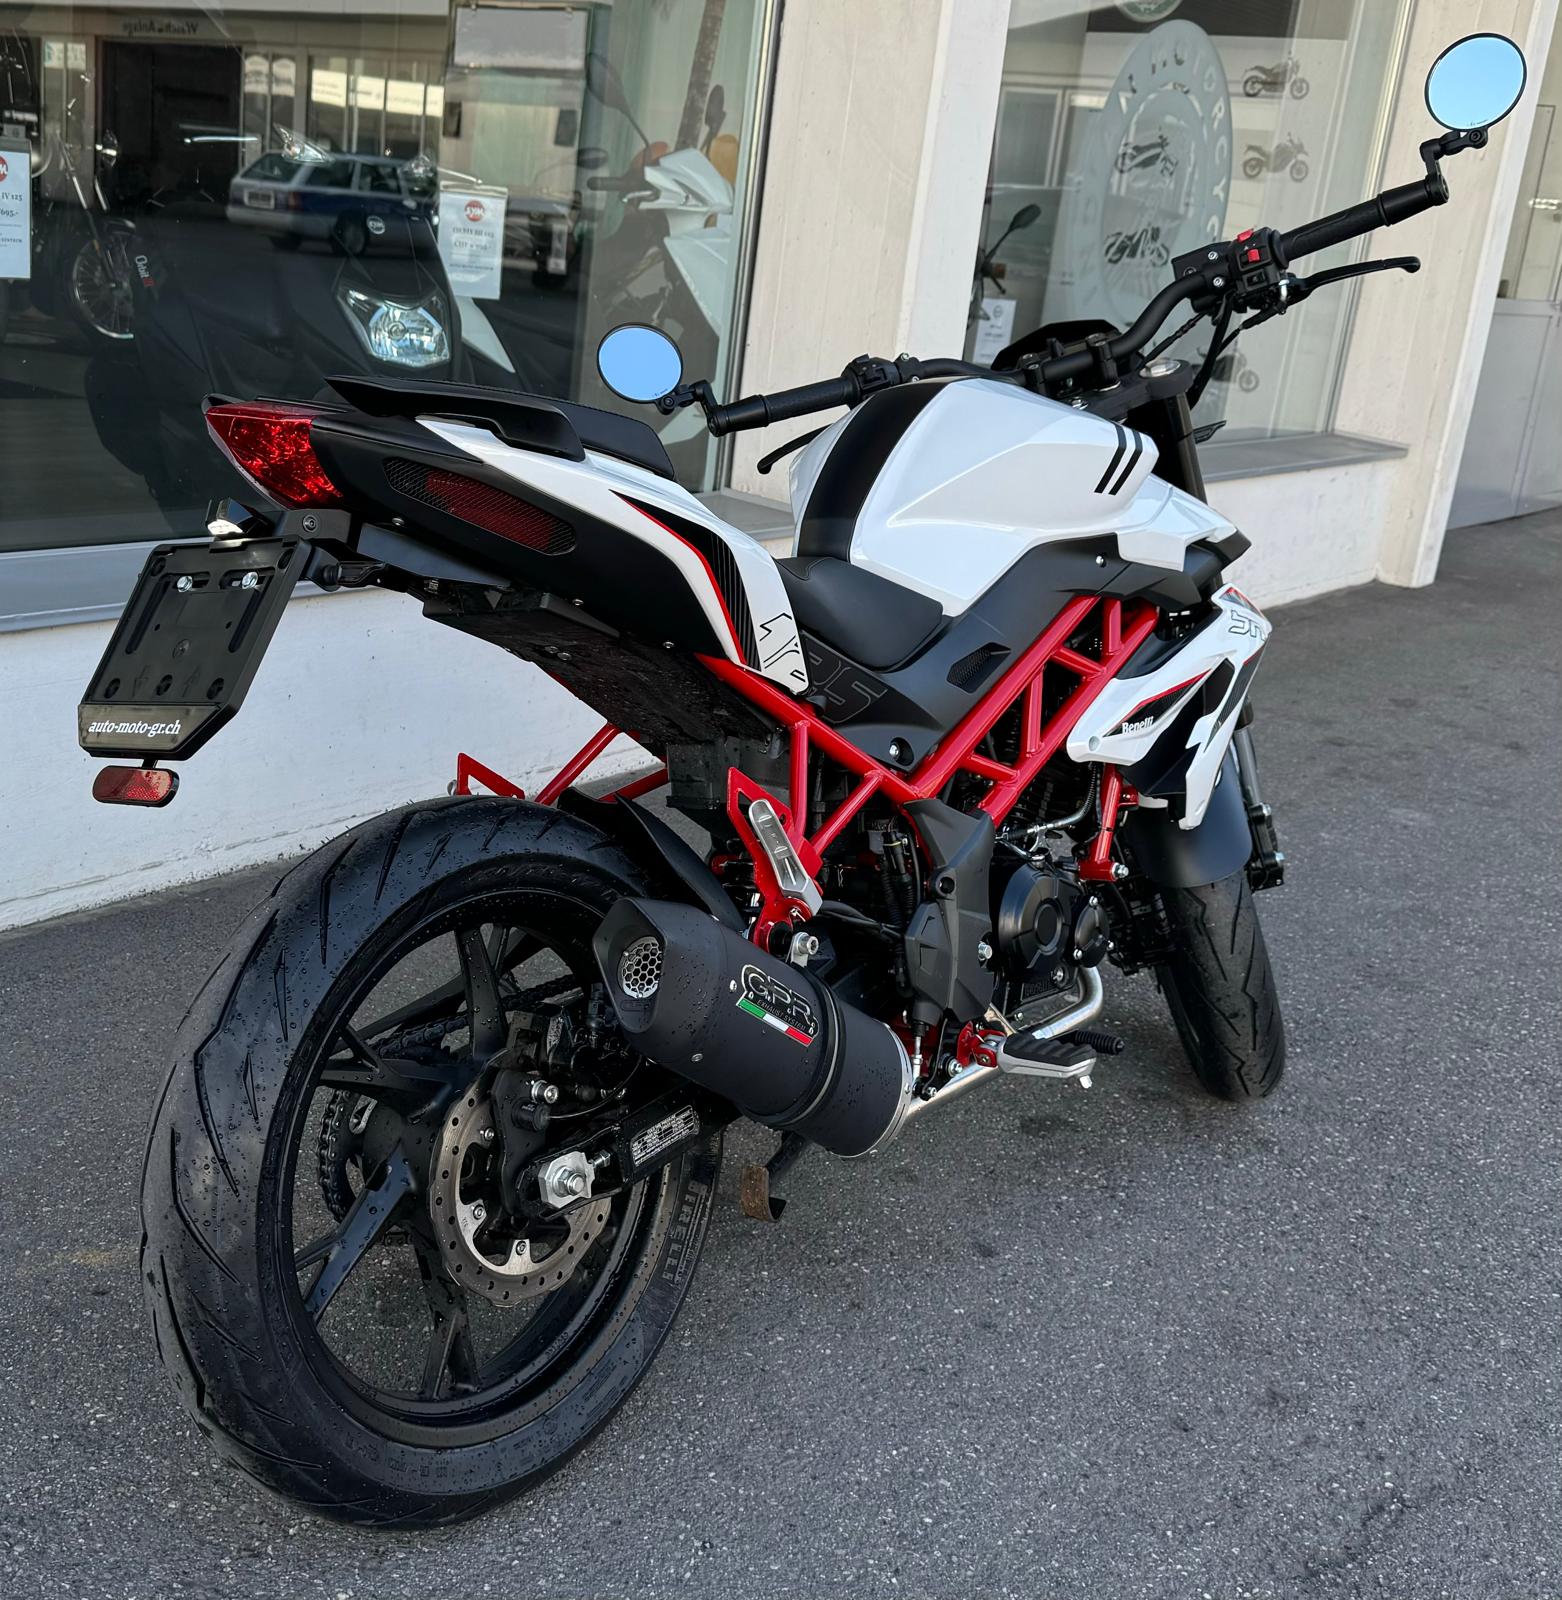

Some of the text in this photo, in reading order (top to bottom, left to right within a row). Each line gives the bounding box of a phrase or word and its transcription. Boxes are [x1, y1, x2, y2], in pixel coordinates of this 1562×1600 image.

[88, 719, 181, 737] auto-moto-gr.ch
[1121, 715, 1154, 735] Benelli
[748, 972, 812, 1026] GPR
